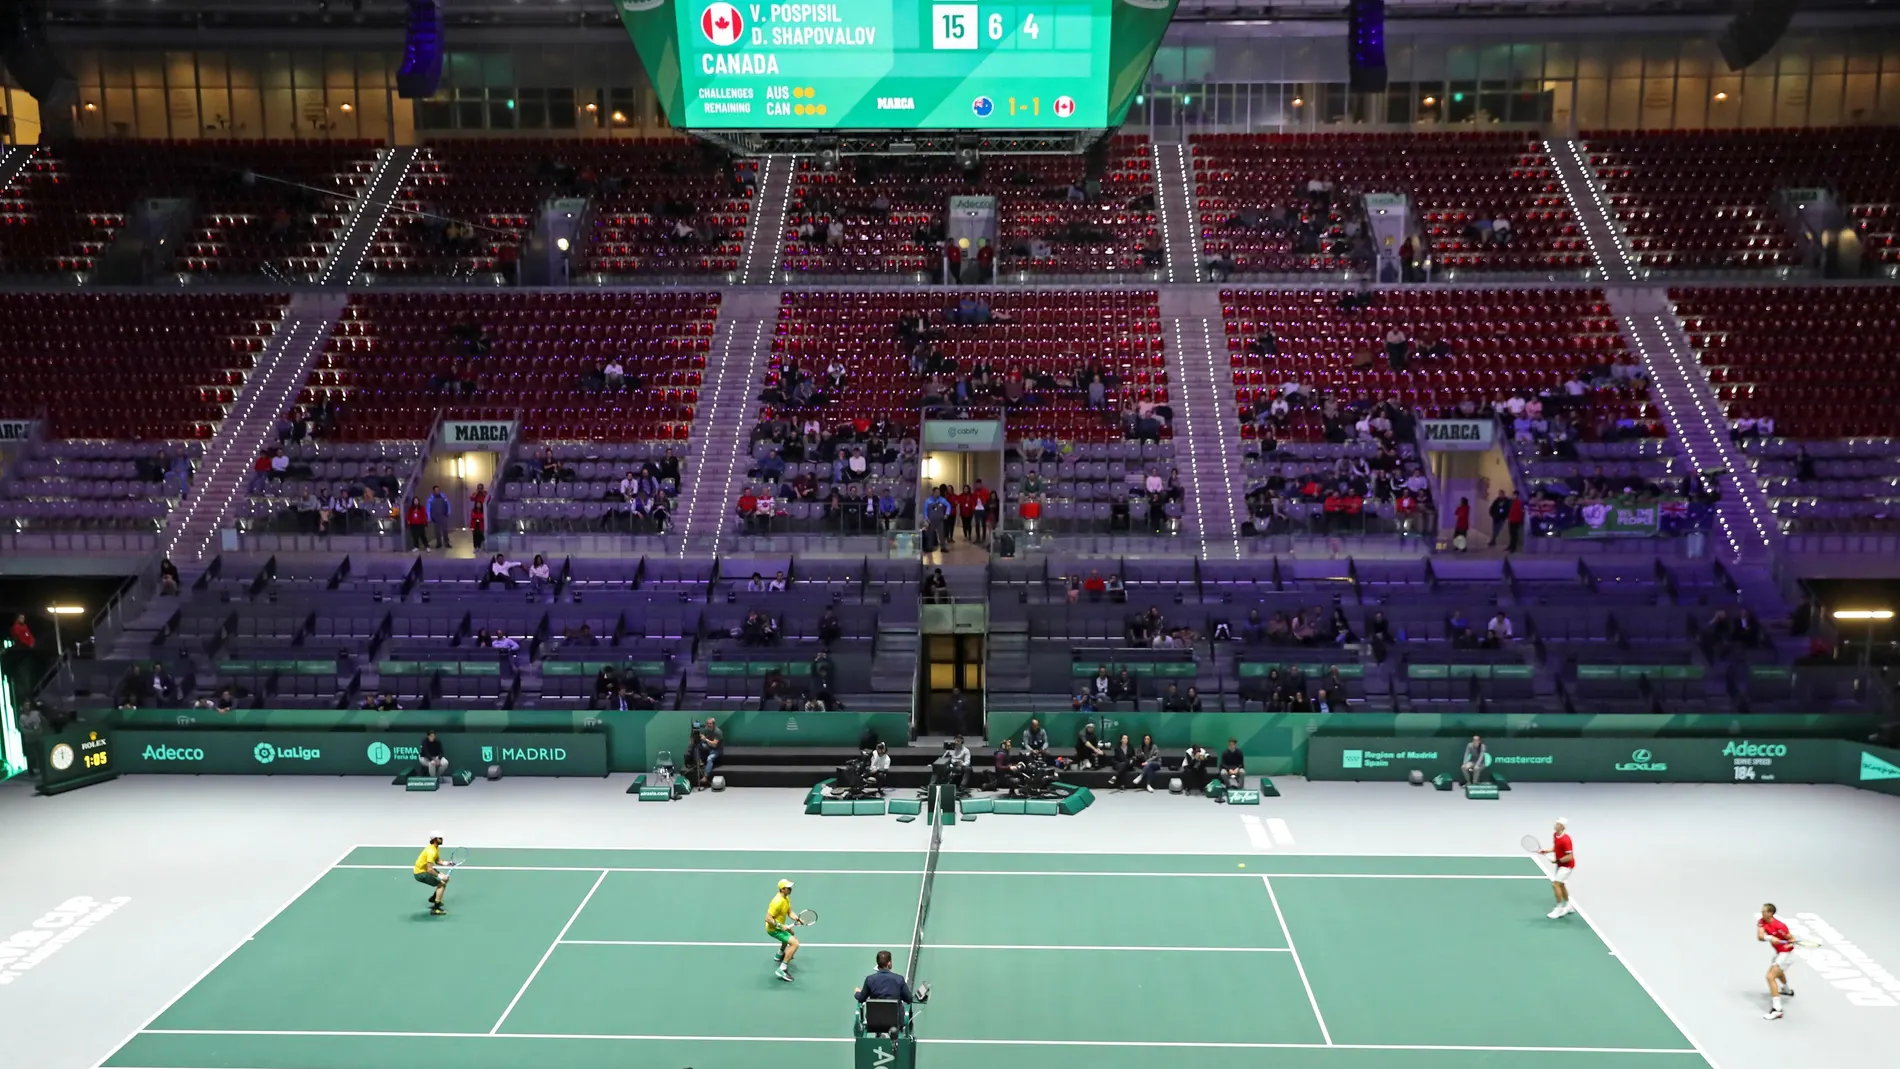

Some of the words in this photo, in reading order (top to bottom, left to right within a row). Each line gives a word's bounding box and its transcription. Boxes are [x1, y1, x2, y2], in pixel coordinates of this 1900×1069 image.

[749, 4, 767, 23] V.
[770, 4, 843, 23] POSPISIL
[942, 14, 965, 39] 15
[988, 13, 1003, 40] 6
[1023, 13, 1039, 40] 4
[751, 27, 768, 45] D.
[772, 27, 876, 45] SHAPOVALOV
[702, 53, 780, 75] CANADA
[698, 88, 754, 99] CHALLENGES
[766, 86, 790, 99] AUS
[704, 102, 751, 113] REMAINING
[766, 102, 791, 115] CAN
[877, 97, 915, 109] MARCA
[455, 425, 509, 441] MARCA
[1424, 424, 1480, 440] MARCA
[81, 738, 107, 750] ROLEX
[1721, 740, 1787, 757] Adecco
[142, 744, 204, 760] Adecco
[277, 746, 321, 760] LaLiga
[393, 747, 419, 755] IFEMA
[502, 747, 567, 760] MADRID
[1364, 751, 1395, 760] Region
[1396, 751, 1406, 759] of
[1407, 751, 1438, 759] Madrid
[83, 751, 107, 768] 1:05
[1364, 759, 1389, 767] Spain
[1494, 755, 1553, 764] mastercard
[1615, 762, 1668, 771] LEXUS
[1733, 766, 1756, 780] 184
